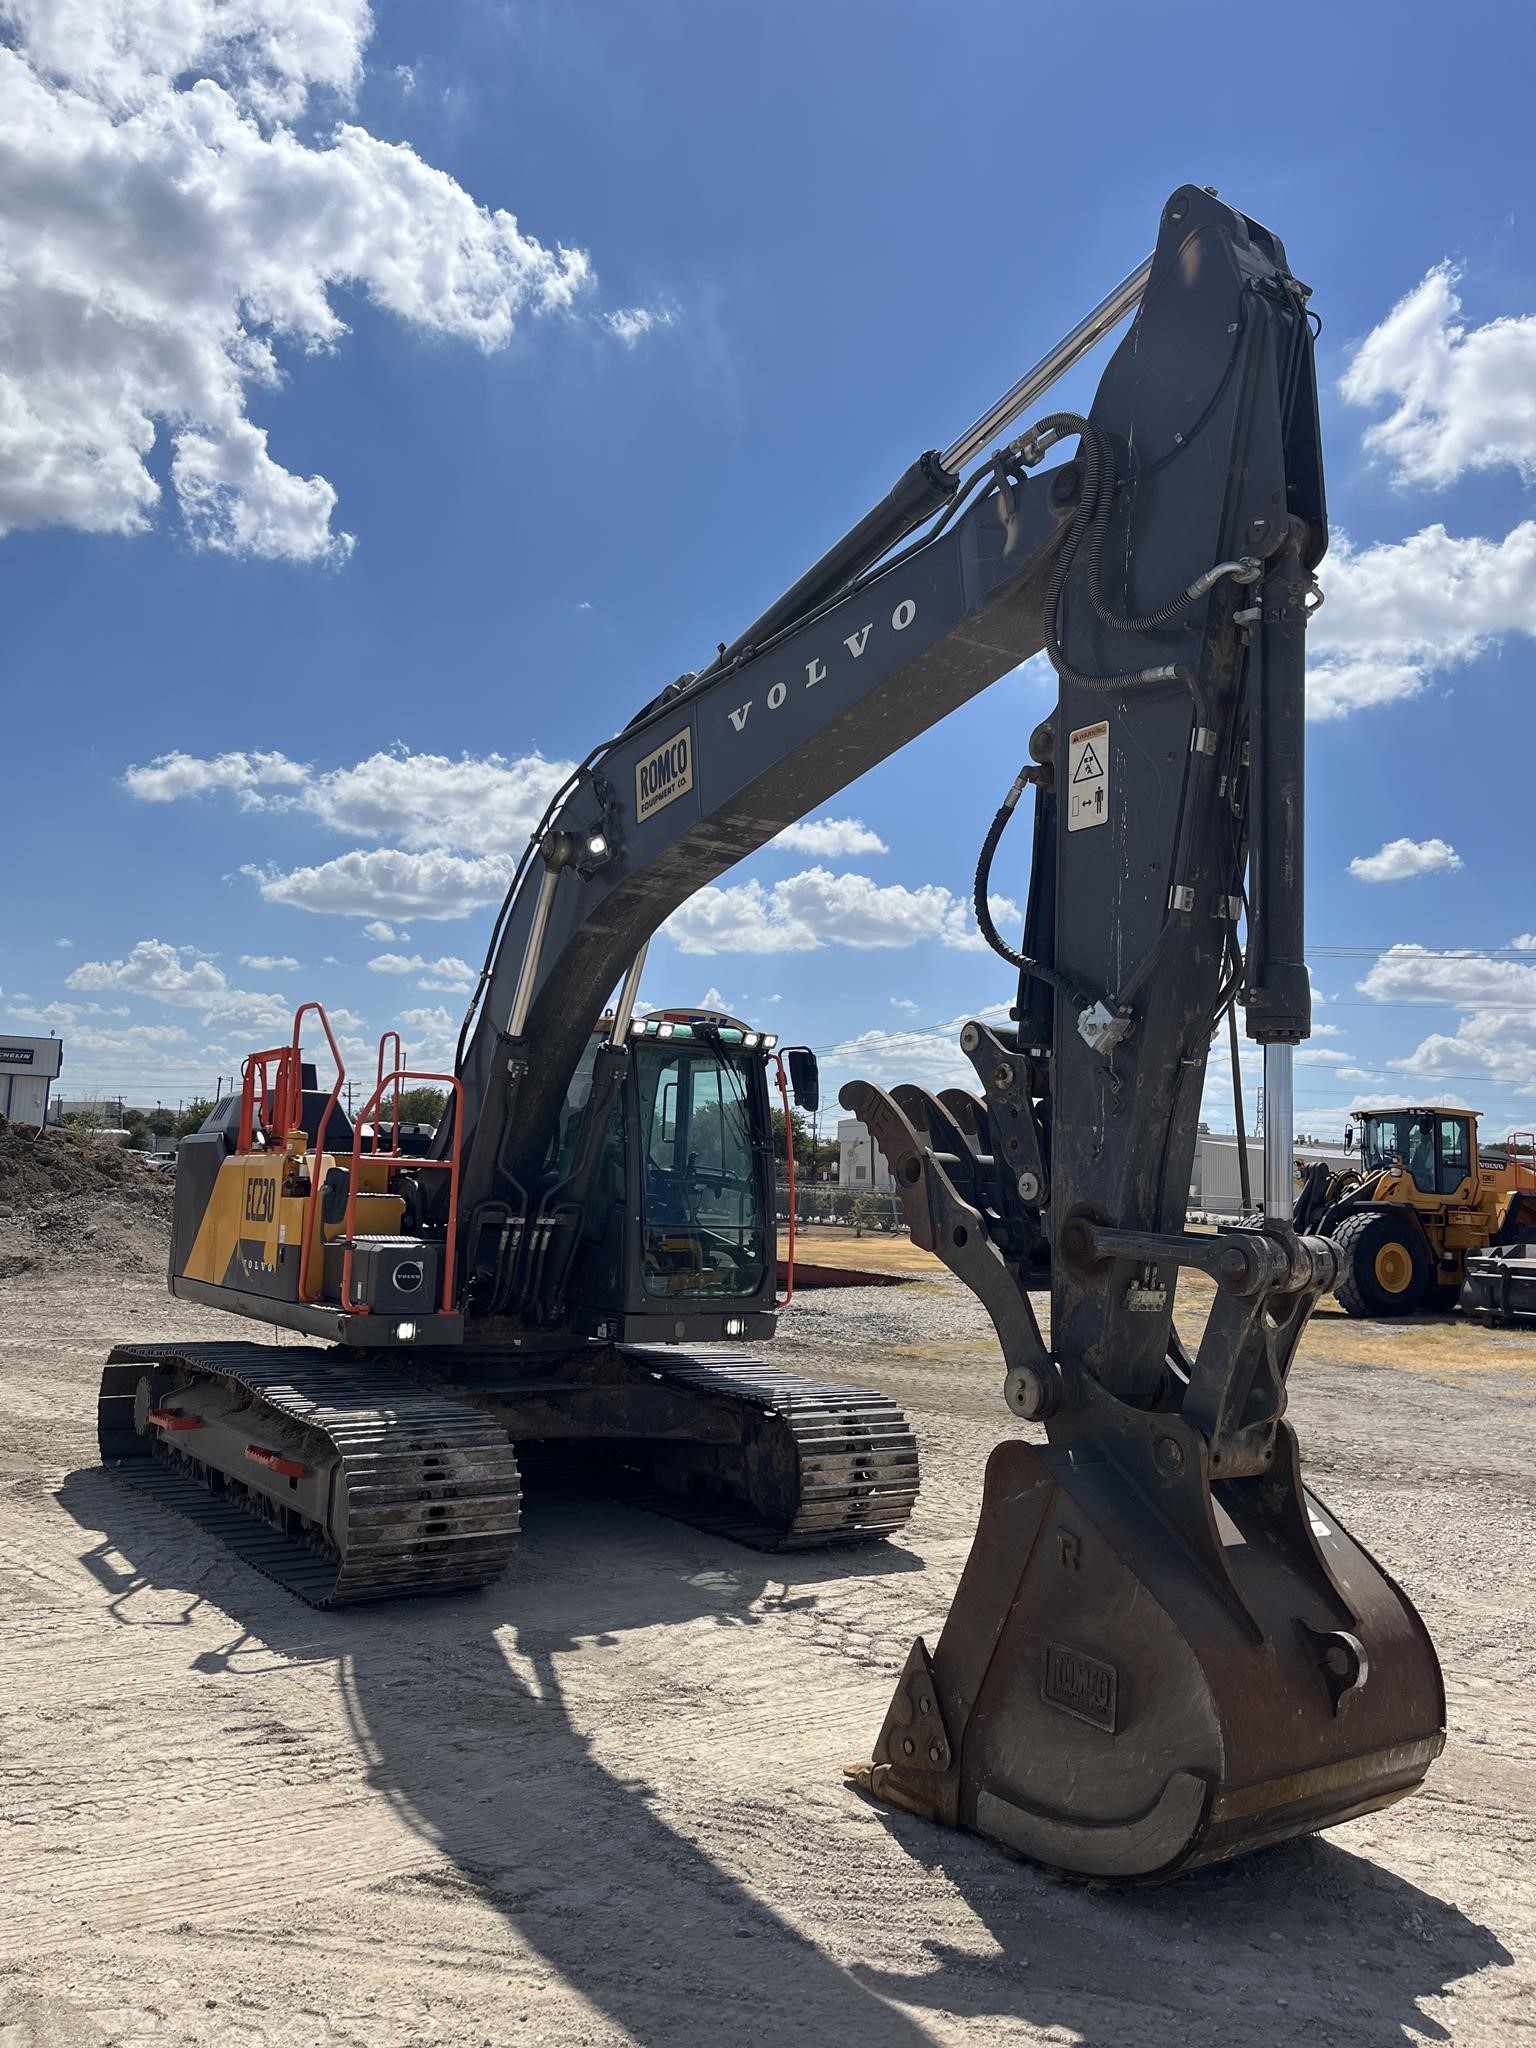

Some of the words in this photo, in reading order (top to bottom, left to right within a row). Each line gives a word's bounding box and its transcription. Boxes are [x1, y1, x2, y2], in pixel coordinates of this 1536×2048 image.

[728, 599, 916, 732] VOLVO
[1079, 726, 1106, 740] WARNING
[641, 738, 687, 800] ROMCO
[641, 783, 675, 813] EQUIPMENT
[1479, 1162, 1504, 1170] VOLVO
[245, 1177, 275, 1223] EC230
